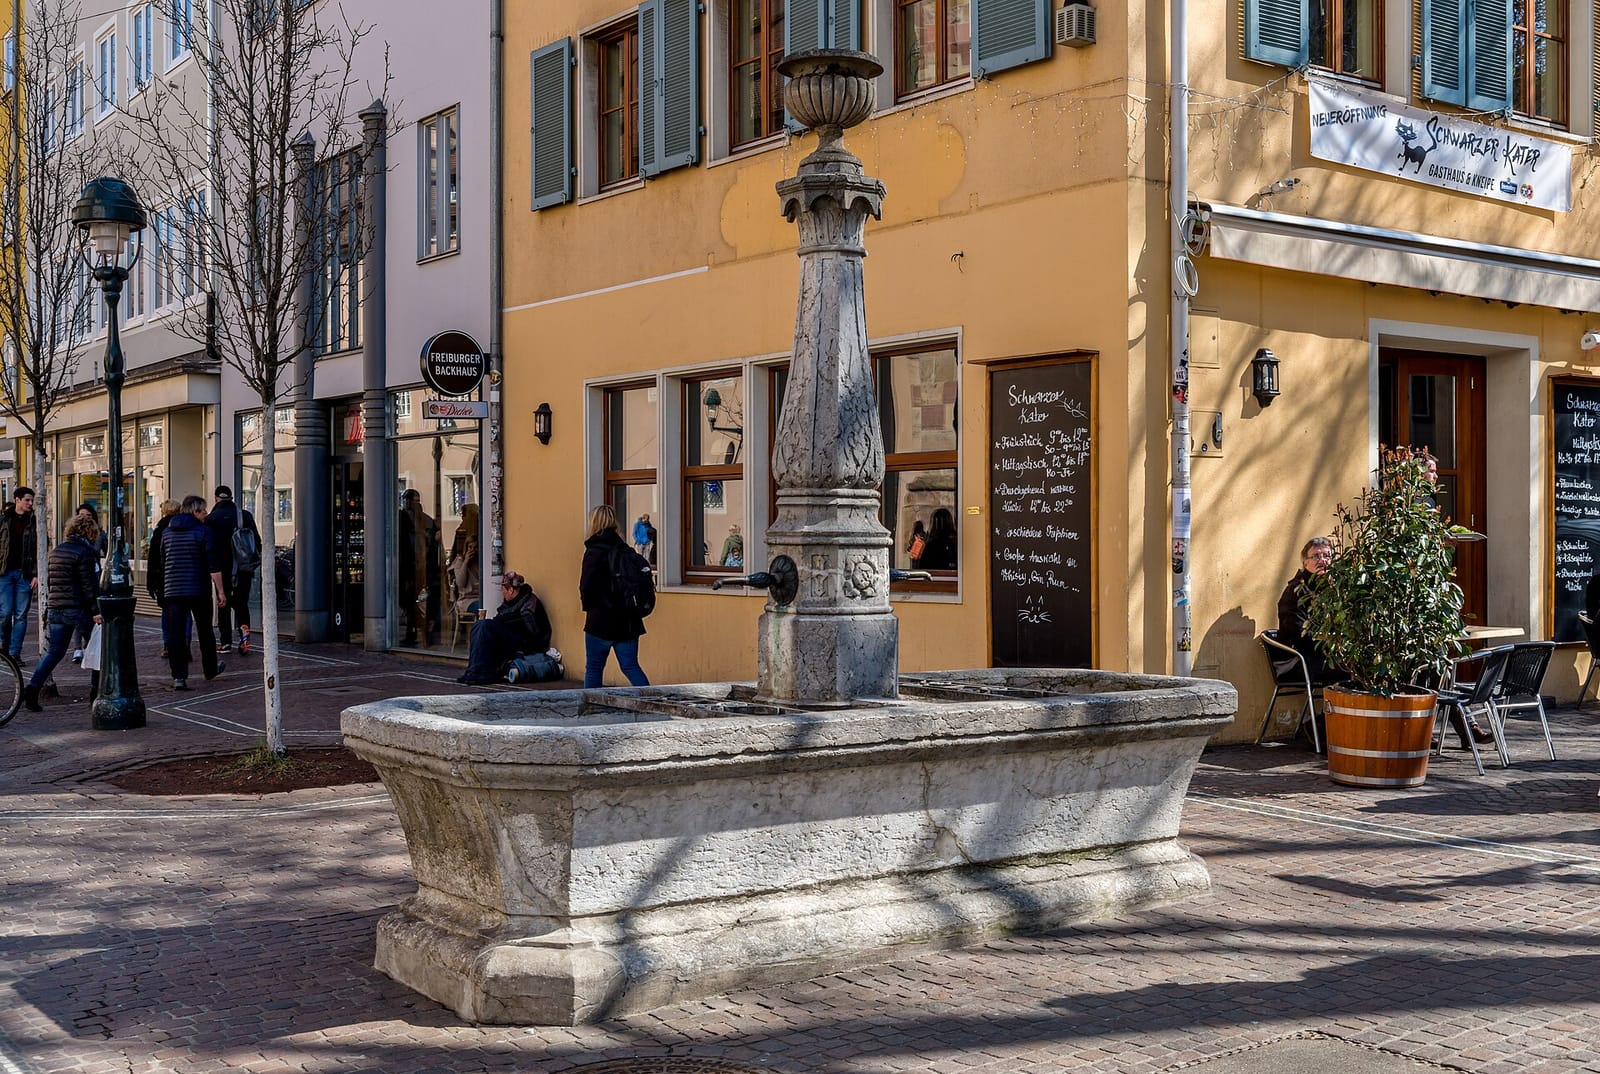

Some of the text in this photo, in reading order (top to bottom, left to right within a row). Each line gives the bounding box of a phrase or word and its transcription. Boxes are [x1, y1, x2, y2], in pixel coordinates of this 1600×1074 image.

[1312, 104, 1388, 128] NEUERÖFFNUNG
[1428, 163, 1466, 184] GASTHAUS
[1466, 171, 1471, 184] &
[1471, 173, 1495, 191] KNEIPE
[430, 352, 481, 364] FREIBURGER
[435, 366, 478, 377] BACKHAUS
[1566, 392, 1600, 411] Schwarze
[1018, 406, 1049, 425] Kater
[1573, 411, 1597, 428] Kater
